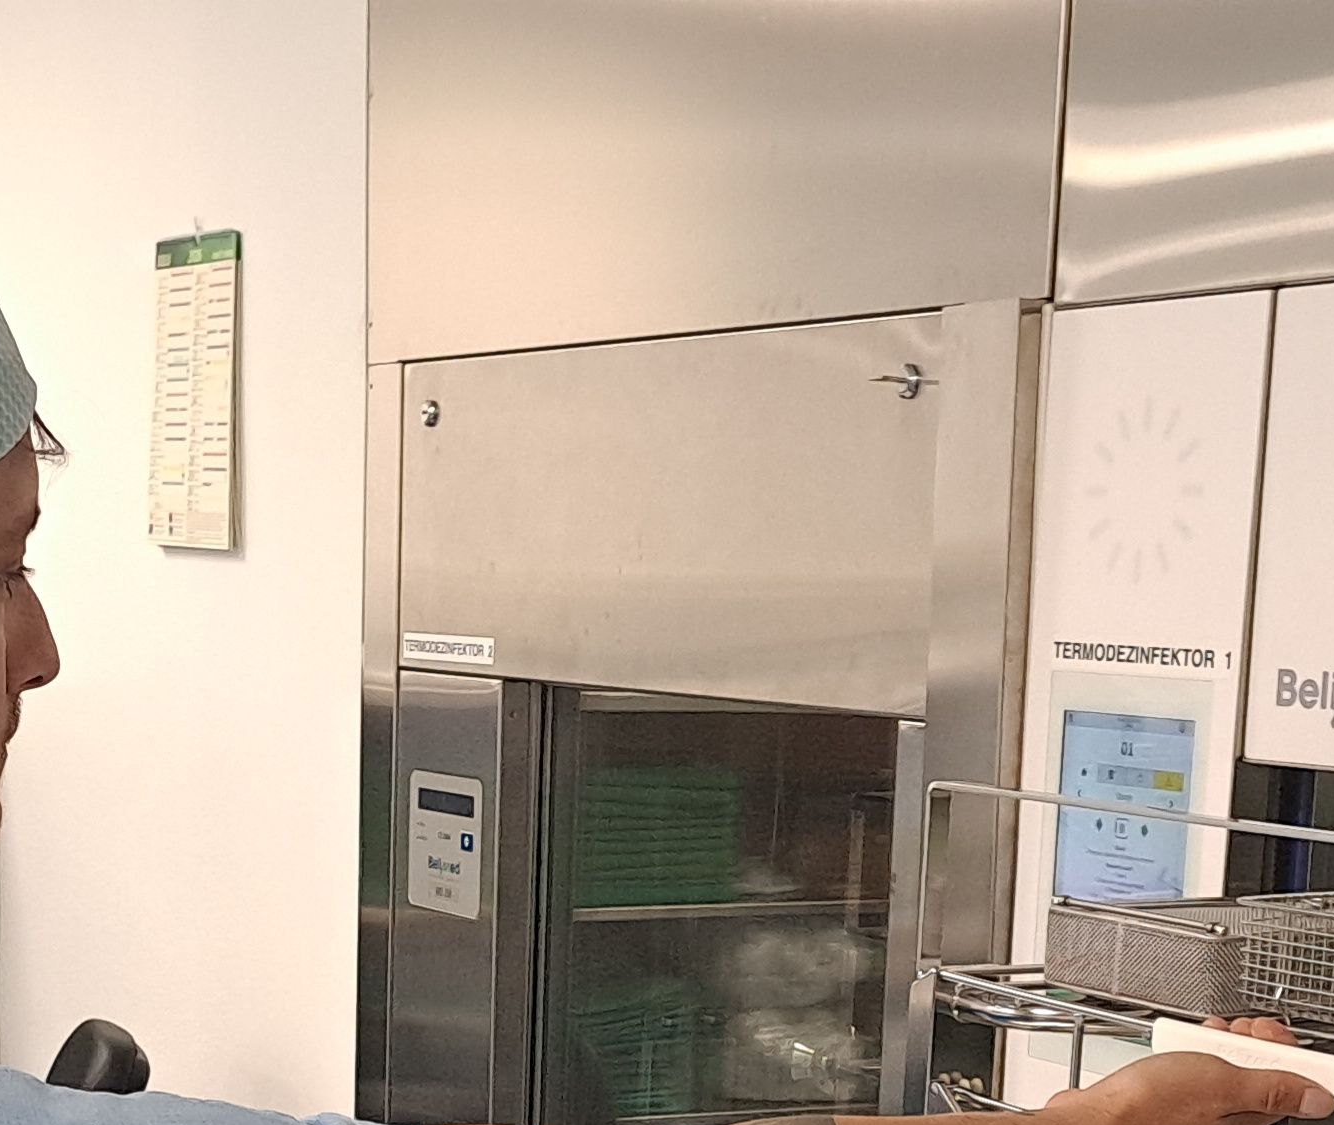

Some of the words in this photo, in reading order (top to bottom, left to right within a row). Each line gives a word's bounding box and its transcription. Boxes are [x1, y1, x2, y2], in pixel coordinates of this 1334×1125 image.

[487, 645, 494, 658] 2
[1053, 641, 1216, 669] TERMODEZINFEKTOR
[1224, 651, 1233, 670] 1
